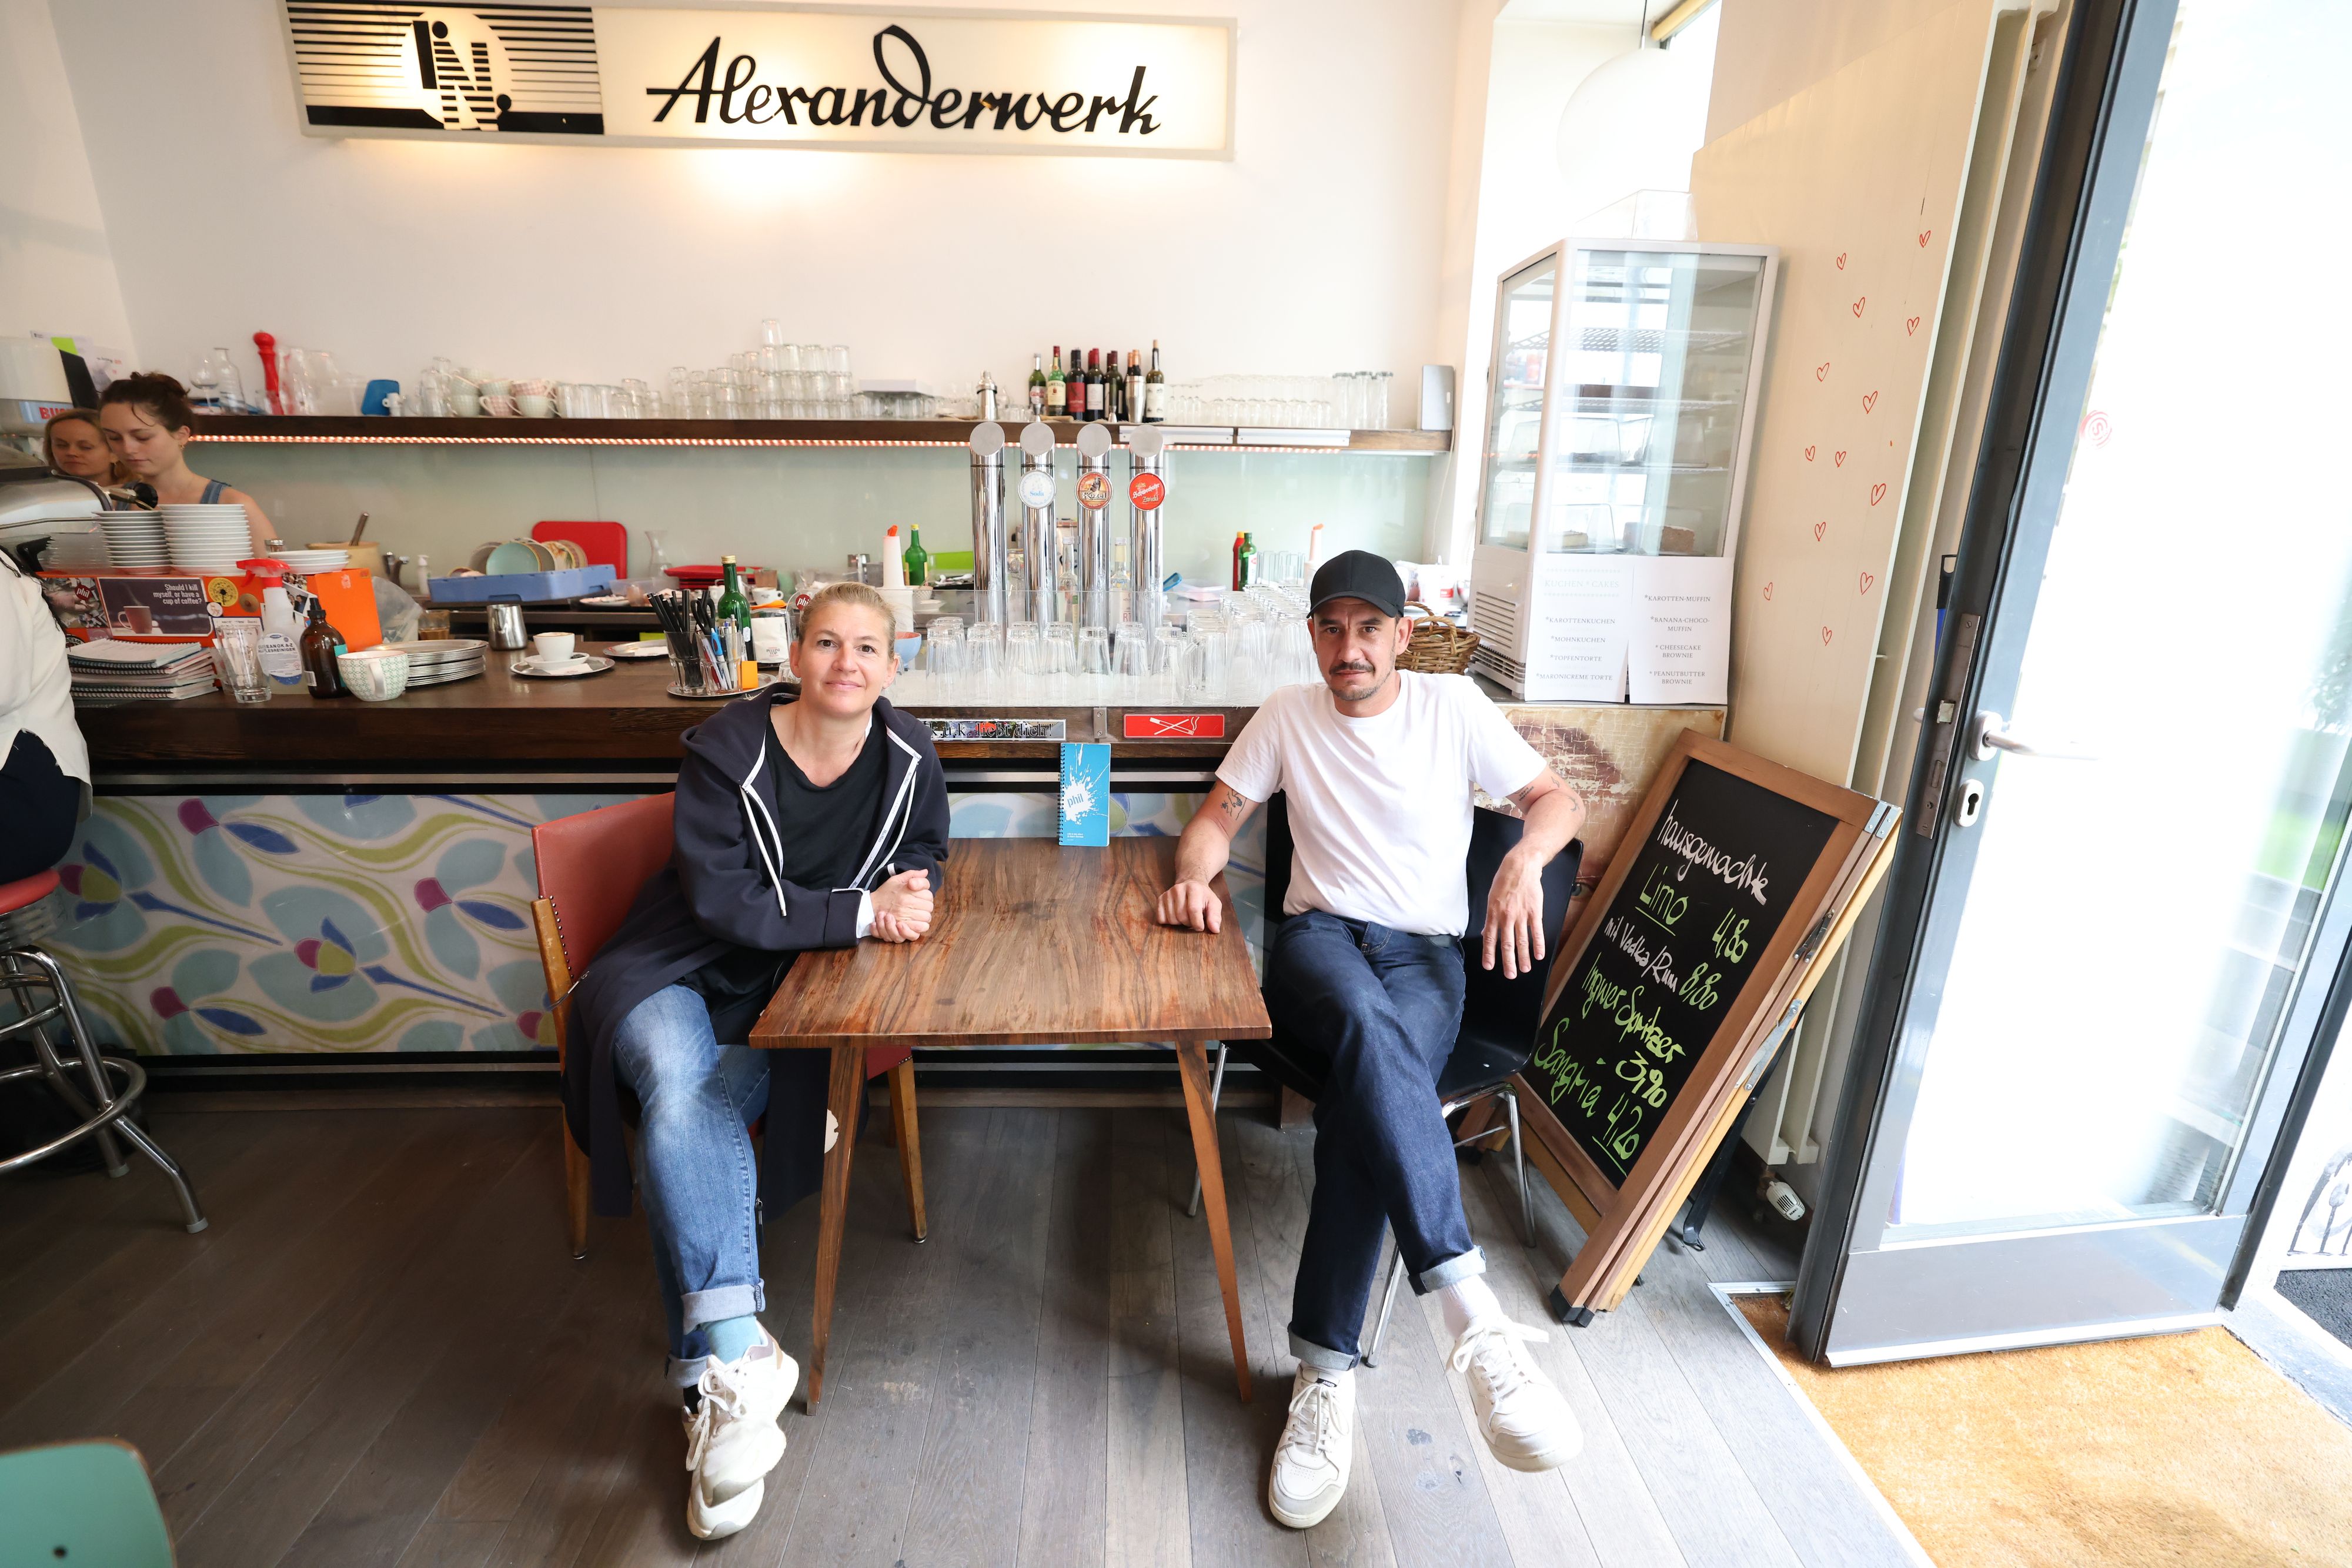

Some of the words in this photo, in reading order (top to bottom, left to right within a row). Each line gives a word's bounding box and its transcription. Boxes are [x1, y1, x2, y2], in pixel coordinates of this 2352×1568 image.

[646, 24, 1161, 135] Alexanderwerk
[1082, 492, 1107, 500] Kozel
[76, 587, 90, 599] phil
[797, 597, 810, 606] phi
[1545, 580, 1583, 588] KUCHEN
[977, 721, 1011, 737] liebt
[1014, 721, 1052, 737] dich!
[1067, 793, 1084, 808] phil
[1656, 798, 1769, 905] hausgemachte
[1639, 862, 1689, 925] Limo
[1604, 915, 1624, 942] mit
[1678, 962, 1722, 1010] 8,80
[1581, 951, 1627, 1019] Ingwer
[1534, 1017, 1606, 1118] Sangria
